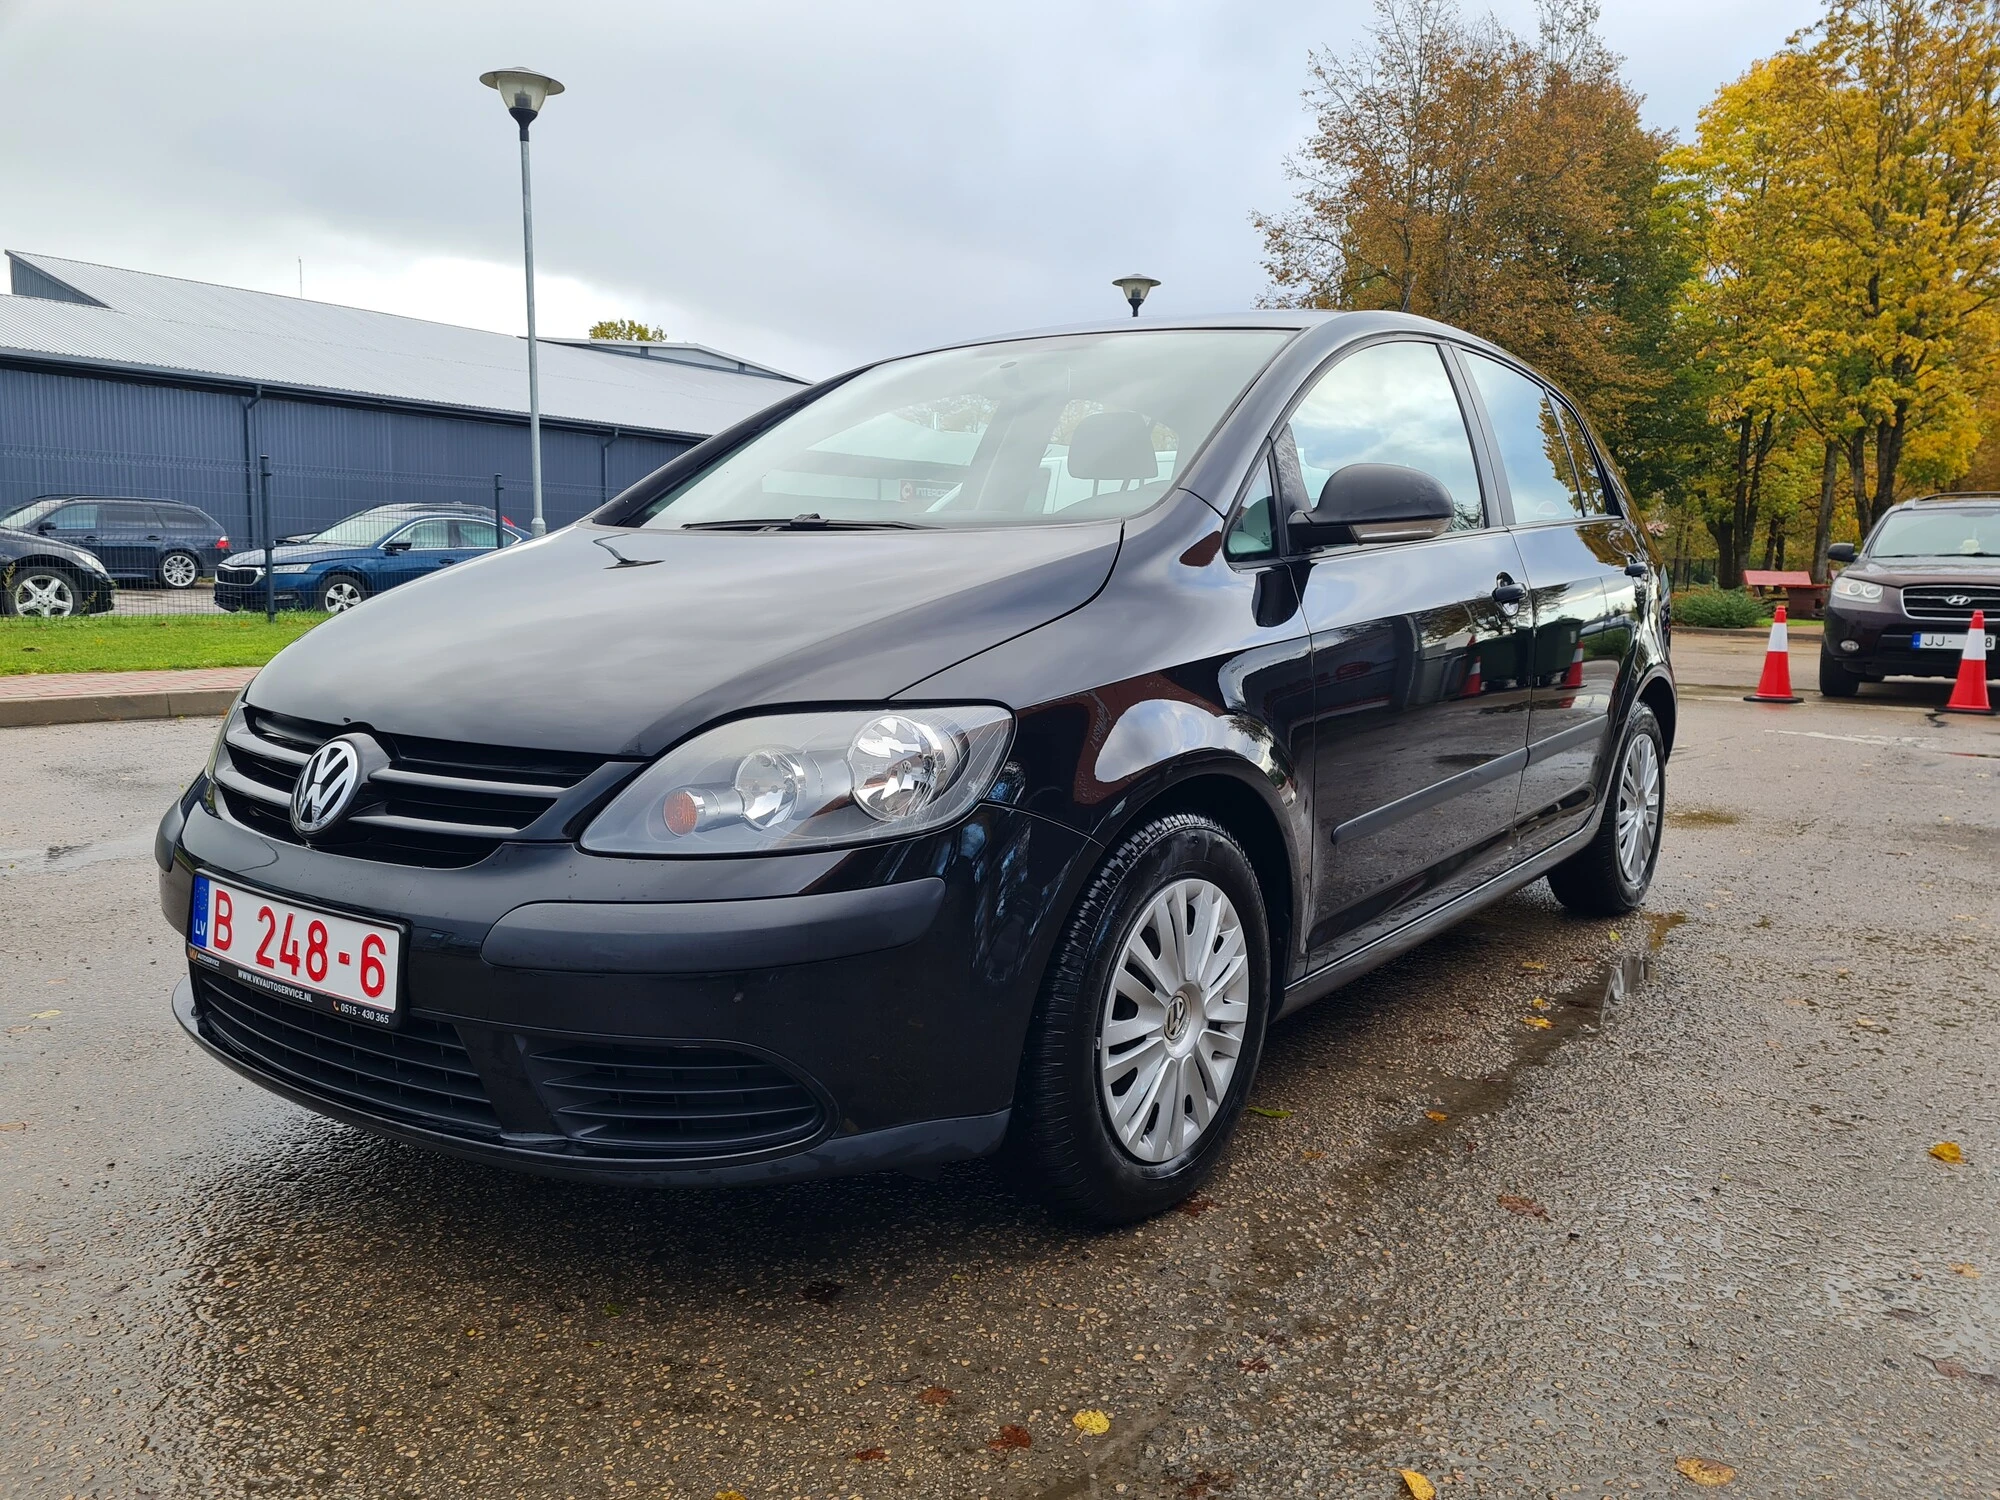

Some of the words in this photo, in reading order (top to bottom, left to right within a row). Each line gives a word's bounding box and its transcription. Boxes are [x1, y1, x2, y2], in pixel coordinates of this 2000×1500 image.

[195, 919, 206, 936] LV
[213, 889, 233, 951] B
[255, 905, 386, 998] 248-6
[237, 969, 312, 1003] WWW.VKVAUTOSERVICE.NL
[340, 1003, 357, 1016] 0515
[361, 1009, 375, 1021] 430
[375, 1012, 389, 1024] 365
